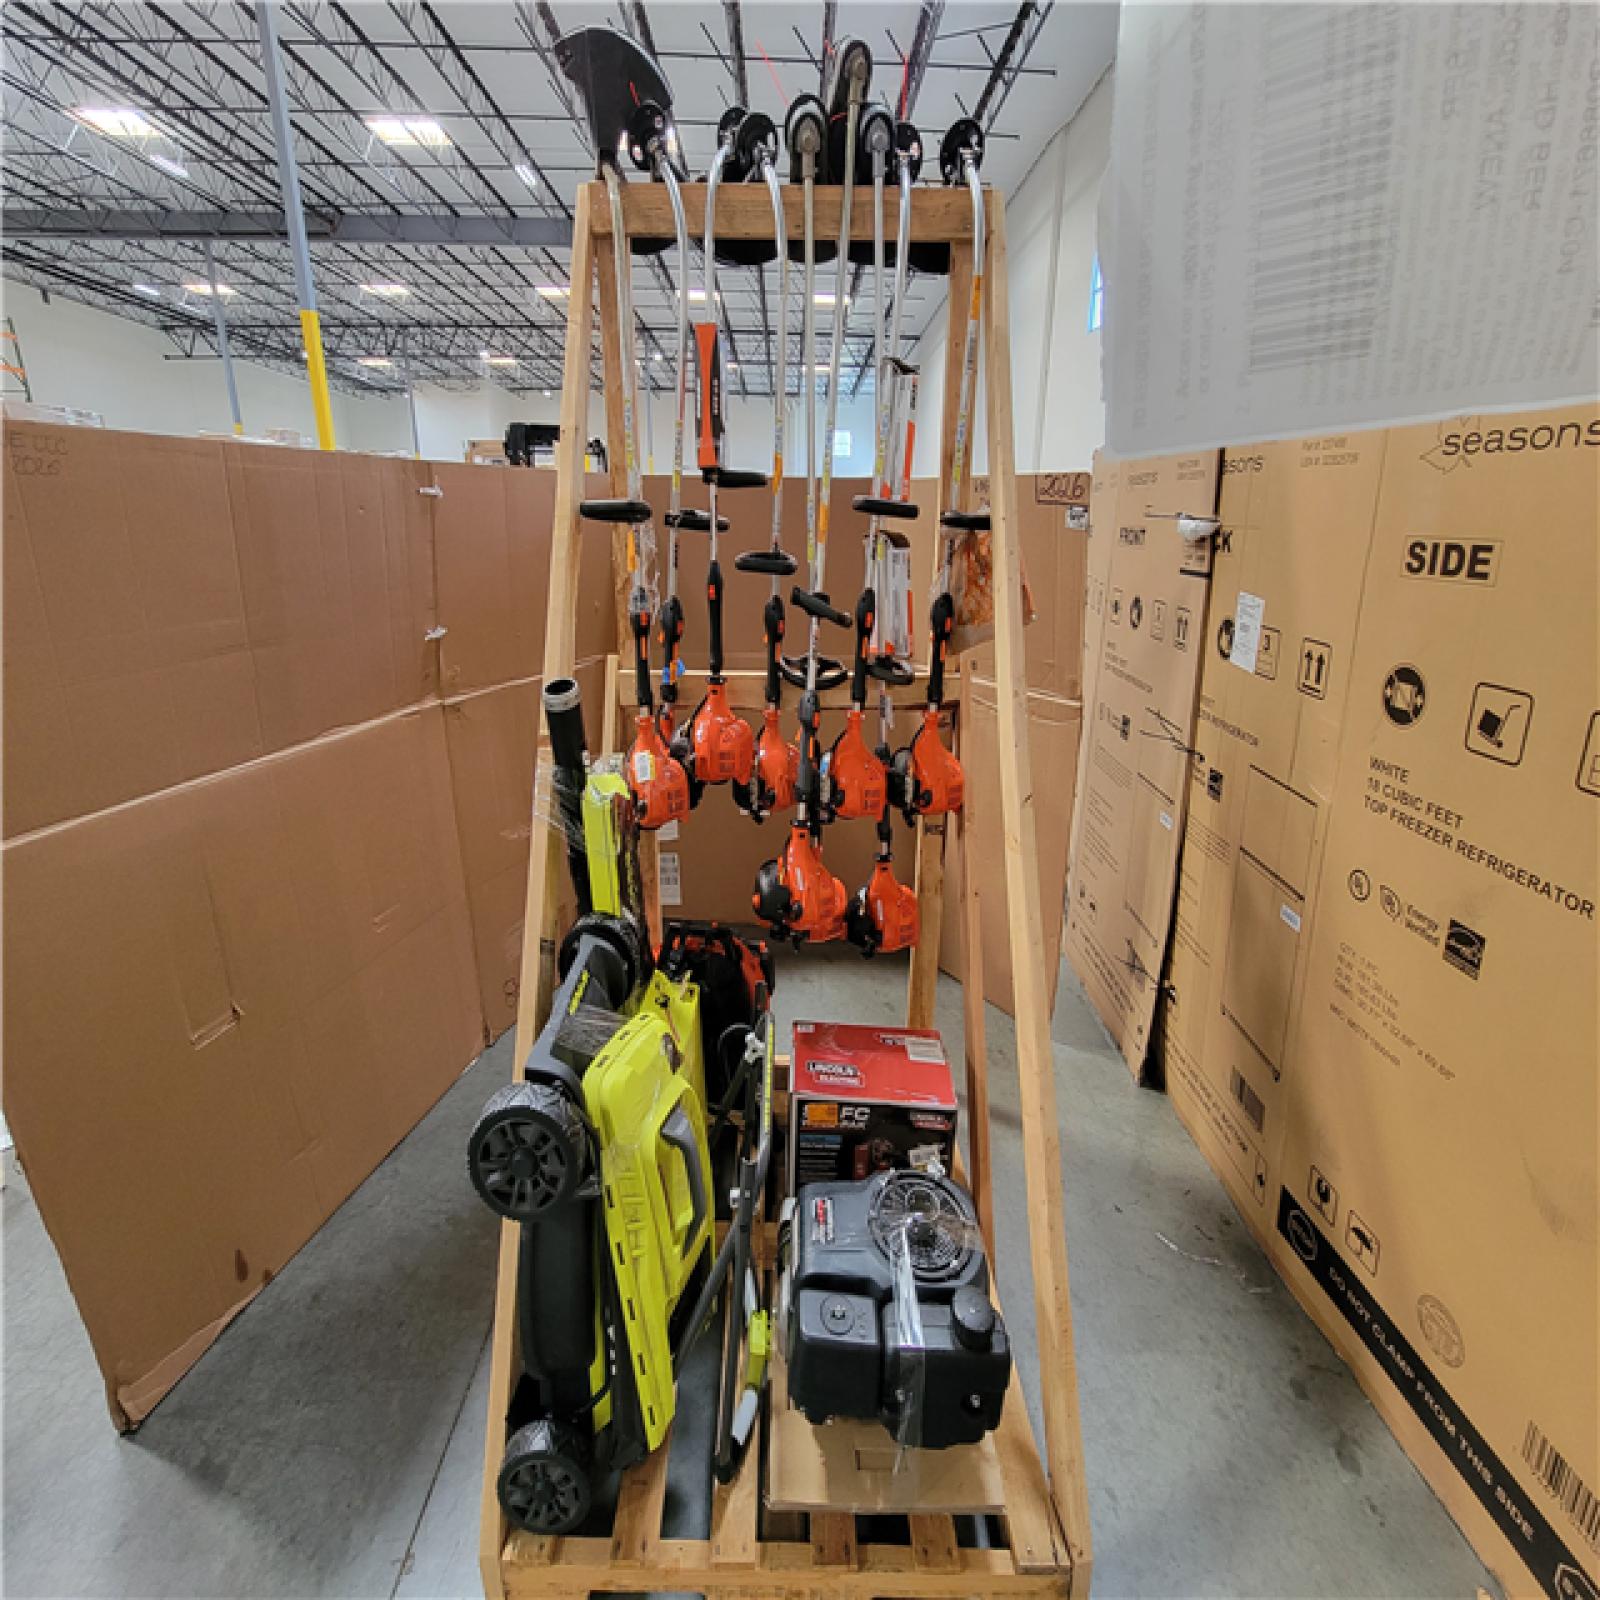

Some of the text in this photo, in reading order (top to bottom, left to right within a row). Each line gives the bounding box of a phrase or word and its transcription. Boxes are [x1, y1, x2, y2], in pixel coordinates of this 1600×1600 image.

[1441, 419, 1600, 456] seasons
[1404, 541, 1494, 581] SIDE
[1369, 755, 1410, 785] WHITE
[1382, 784, 1424, 812] CUBIC
[1425, 802, 1464, 830] FEET
[1364, 794, 1596, 921] TOP FREEZER REFRIGERATOR
[1494, 1483, 1535, 1543] SIDE
